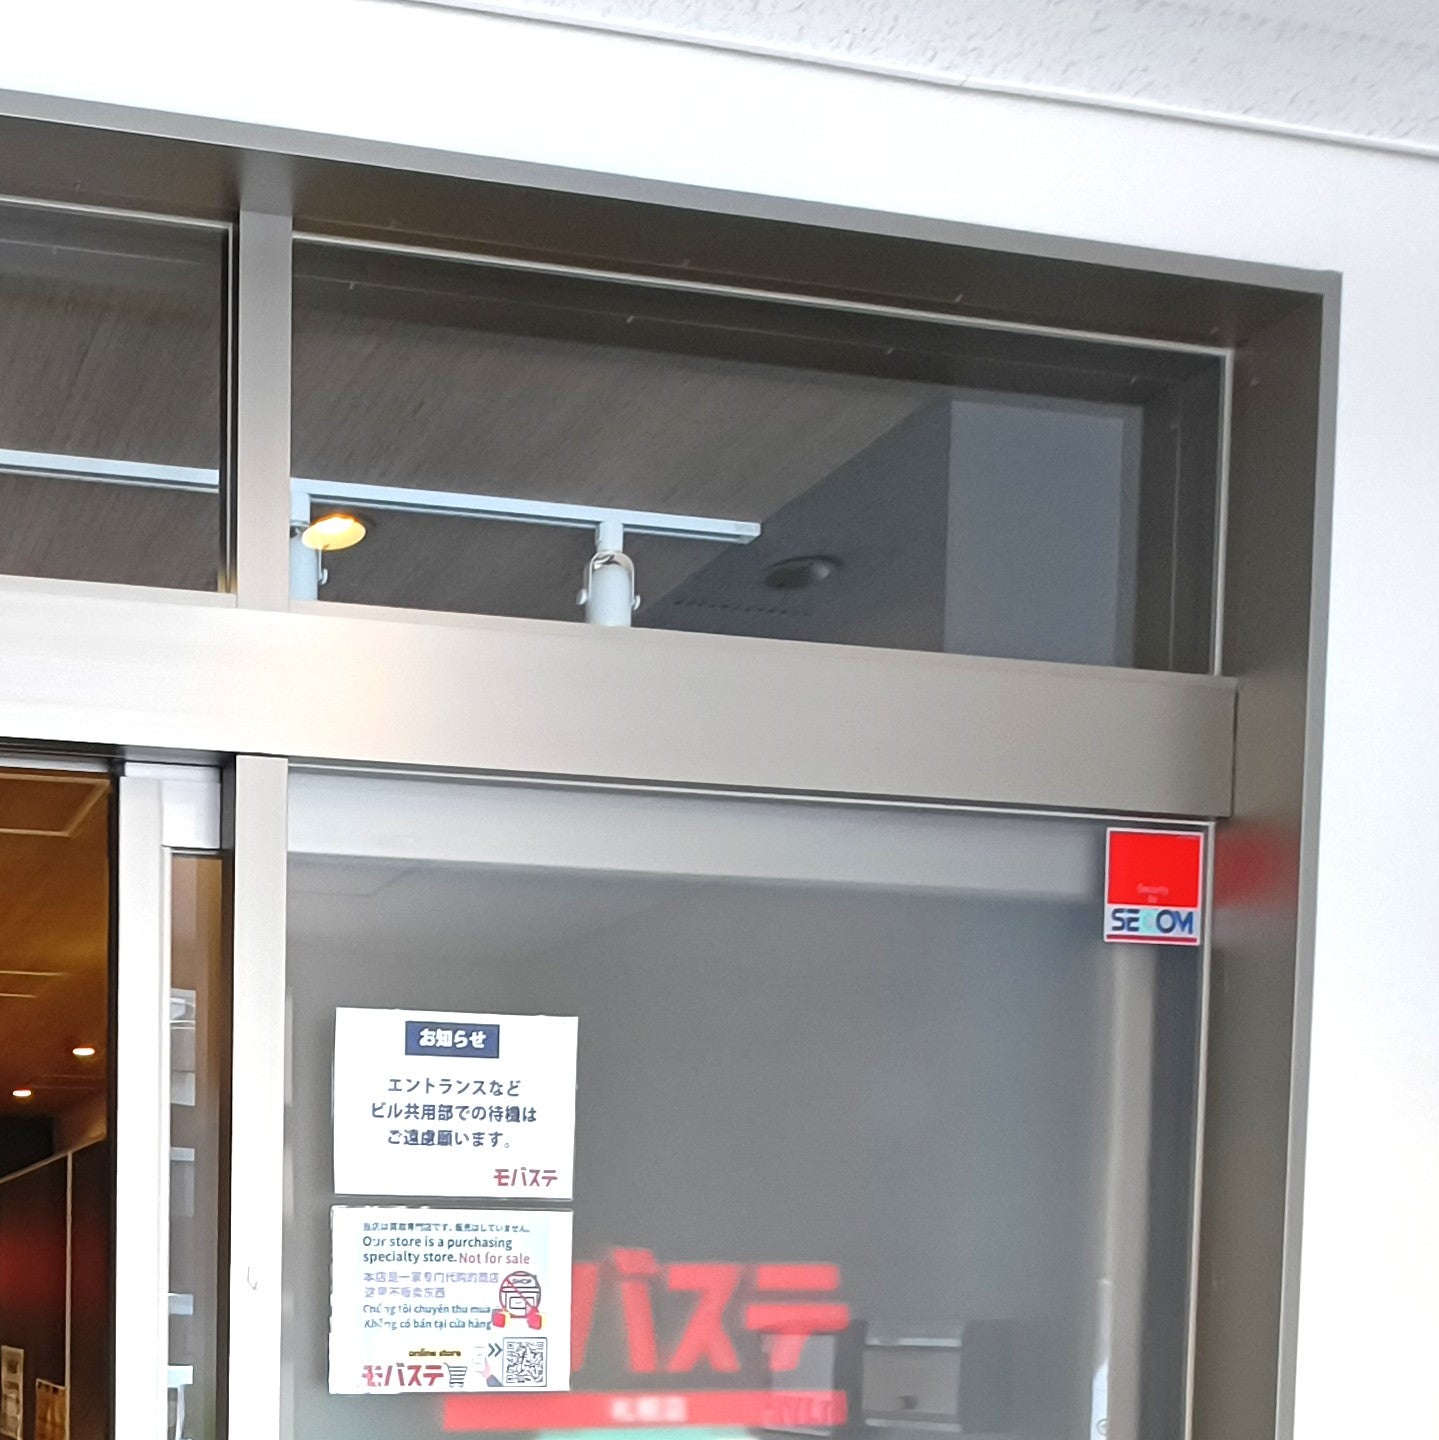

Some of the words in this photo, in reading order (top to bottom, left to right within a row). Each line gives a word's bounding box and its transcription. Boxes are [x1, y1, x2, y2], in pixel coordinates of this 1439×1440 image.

[419, 1028, 486, 1049] お知らせ
[388, 1078, 522, 1097] エントランスなど
[371, 1102, 537, 1123] ビル共用部での待機は
[387, 1129, 510, 1148] ご遠慮願います。
[493, 1167, 558, 1187] モバステ
[362, 1235, 387, 1247] Our
[389, 1237, 422, 1247] store
[425, 1235, 435, 1247] is
[437, 1239, 444, 1247] a
[447, 1236, 513, 1251] purchasing
[363, 1250, 420, 1264] specialty
[459, 1252, 481, 1264] Not
[485, 1251, 503, 1264] for
[505, 1252, 530, 1264] sale
[452, 1304, 468, 1313] thu
[570, 1247, 850, 1373] バステ
